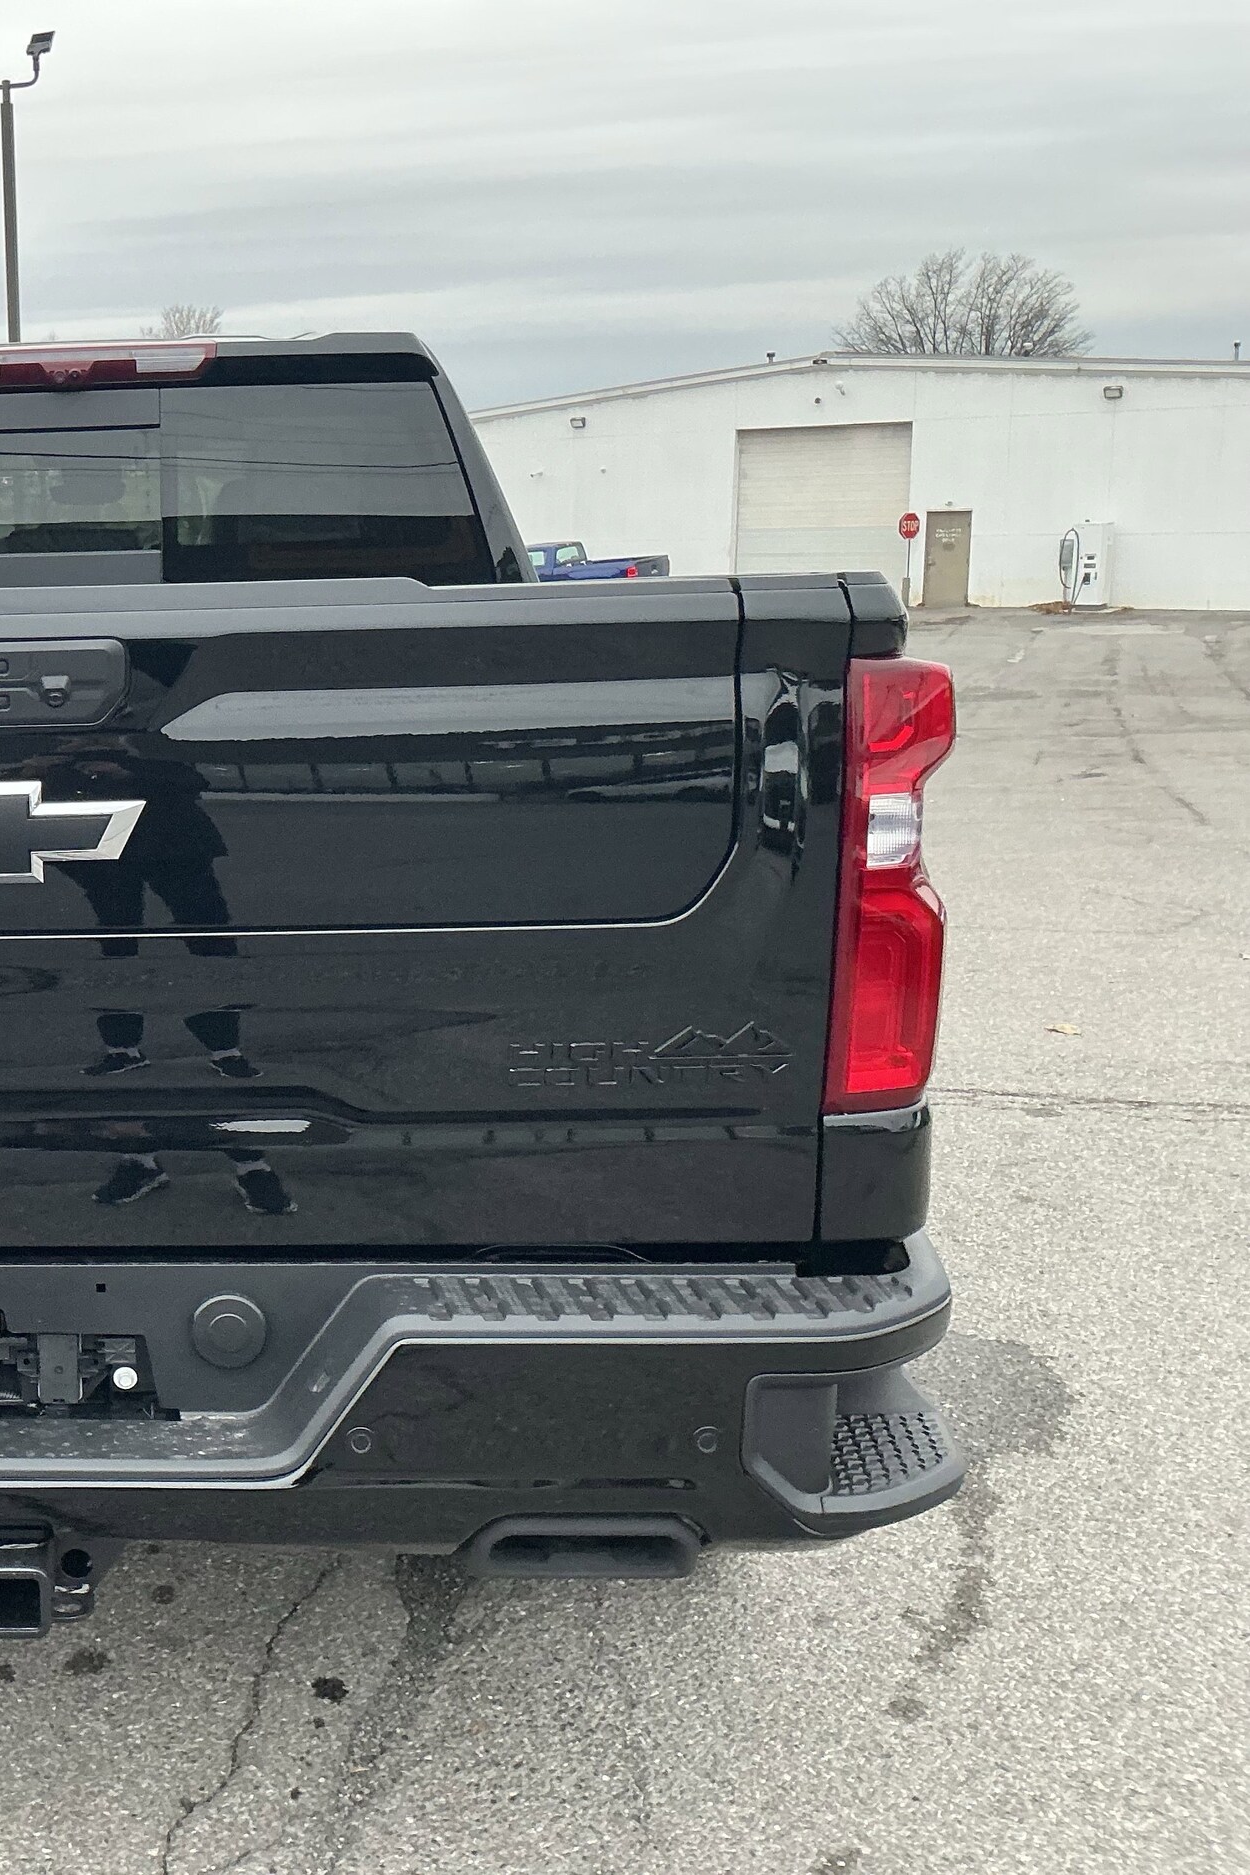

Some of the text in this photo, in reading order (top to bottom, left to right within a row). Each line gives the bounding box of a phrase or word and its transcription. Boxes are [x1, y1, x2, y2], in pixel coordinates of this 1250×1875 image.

[902, 520, 919, 532] STOP
[509, 1041, 650, 1062] HIGH
[508, 1062, 790, 1087] COUNTRY
